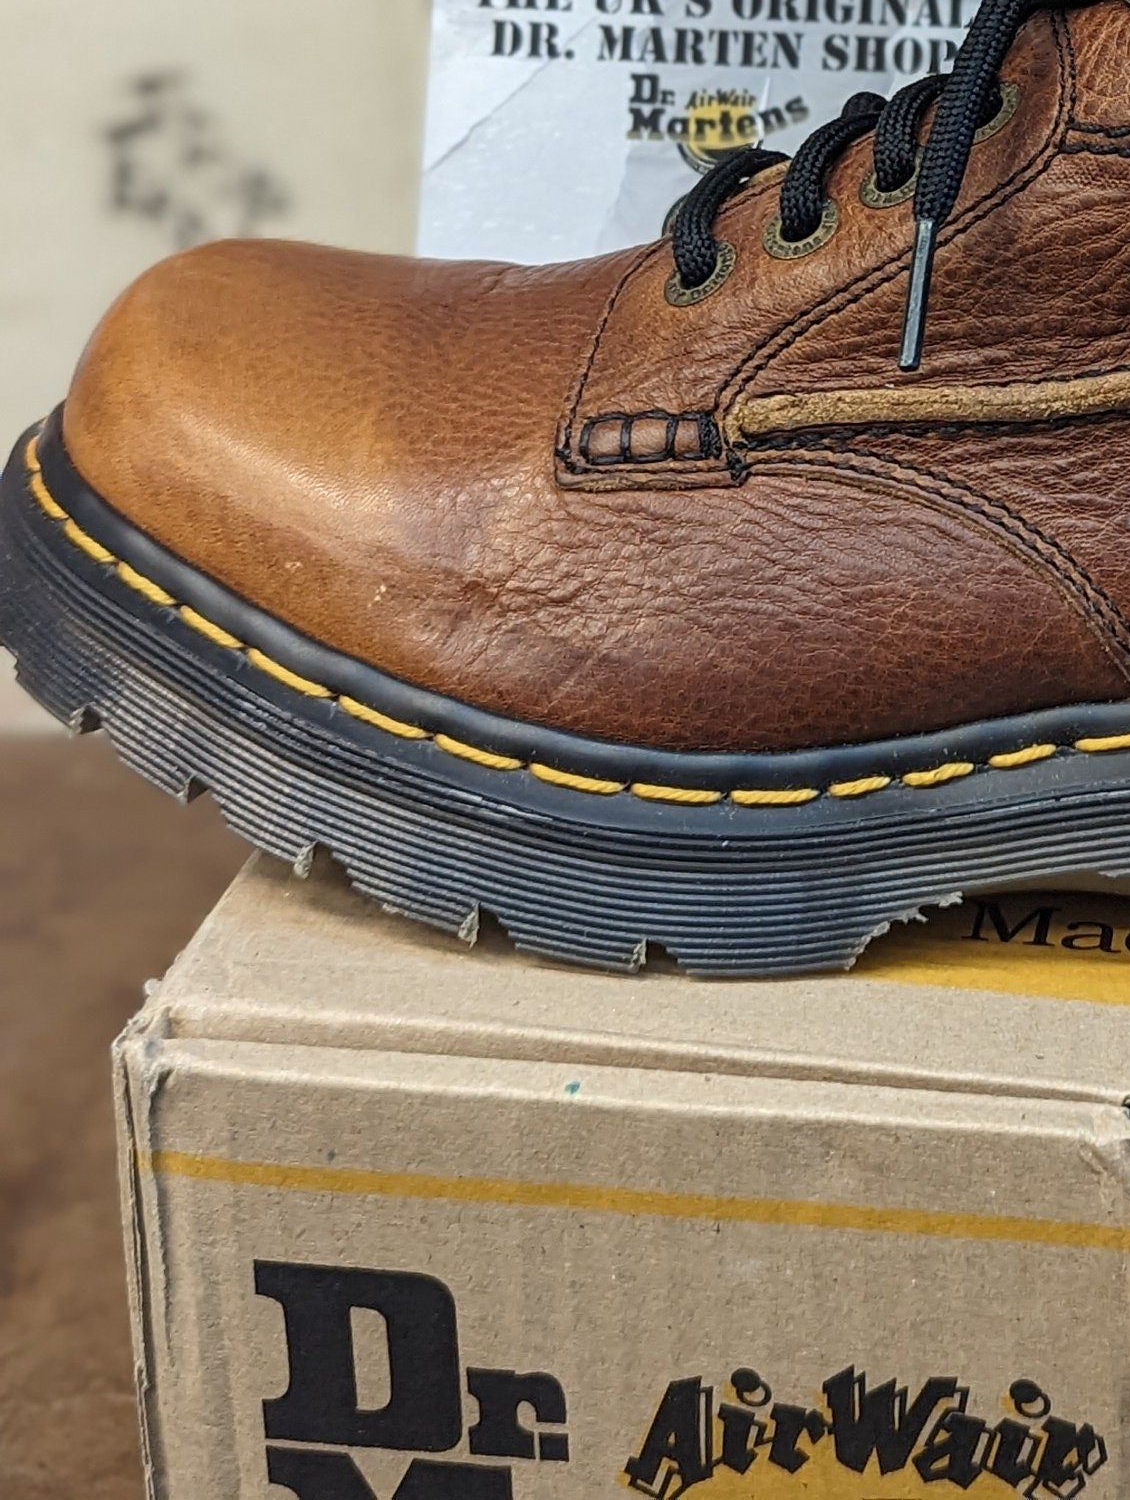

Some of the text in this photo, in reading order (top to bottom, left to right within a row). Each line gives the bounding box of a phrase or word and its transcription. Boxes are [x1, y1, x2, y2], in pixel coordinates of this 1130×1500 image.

[490, 19, 956, 76] DR. MARTEN SHOP
[627, 94, 811, 141] Martens
[253, 1258, 570, 1462] Dr.
[622, 1363, 1108, 1500] AirWair
